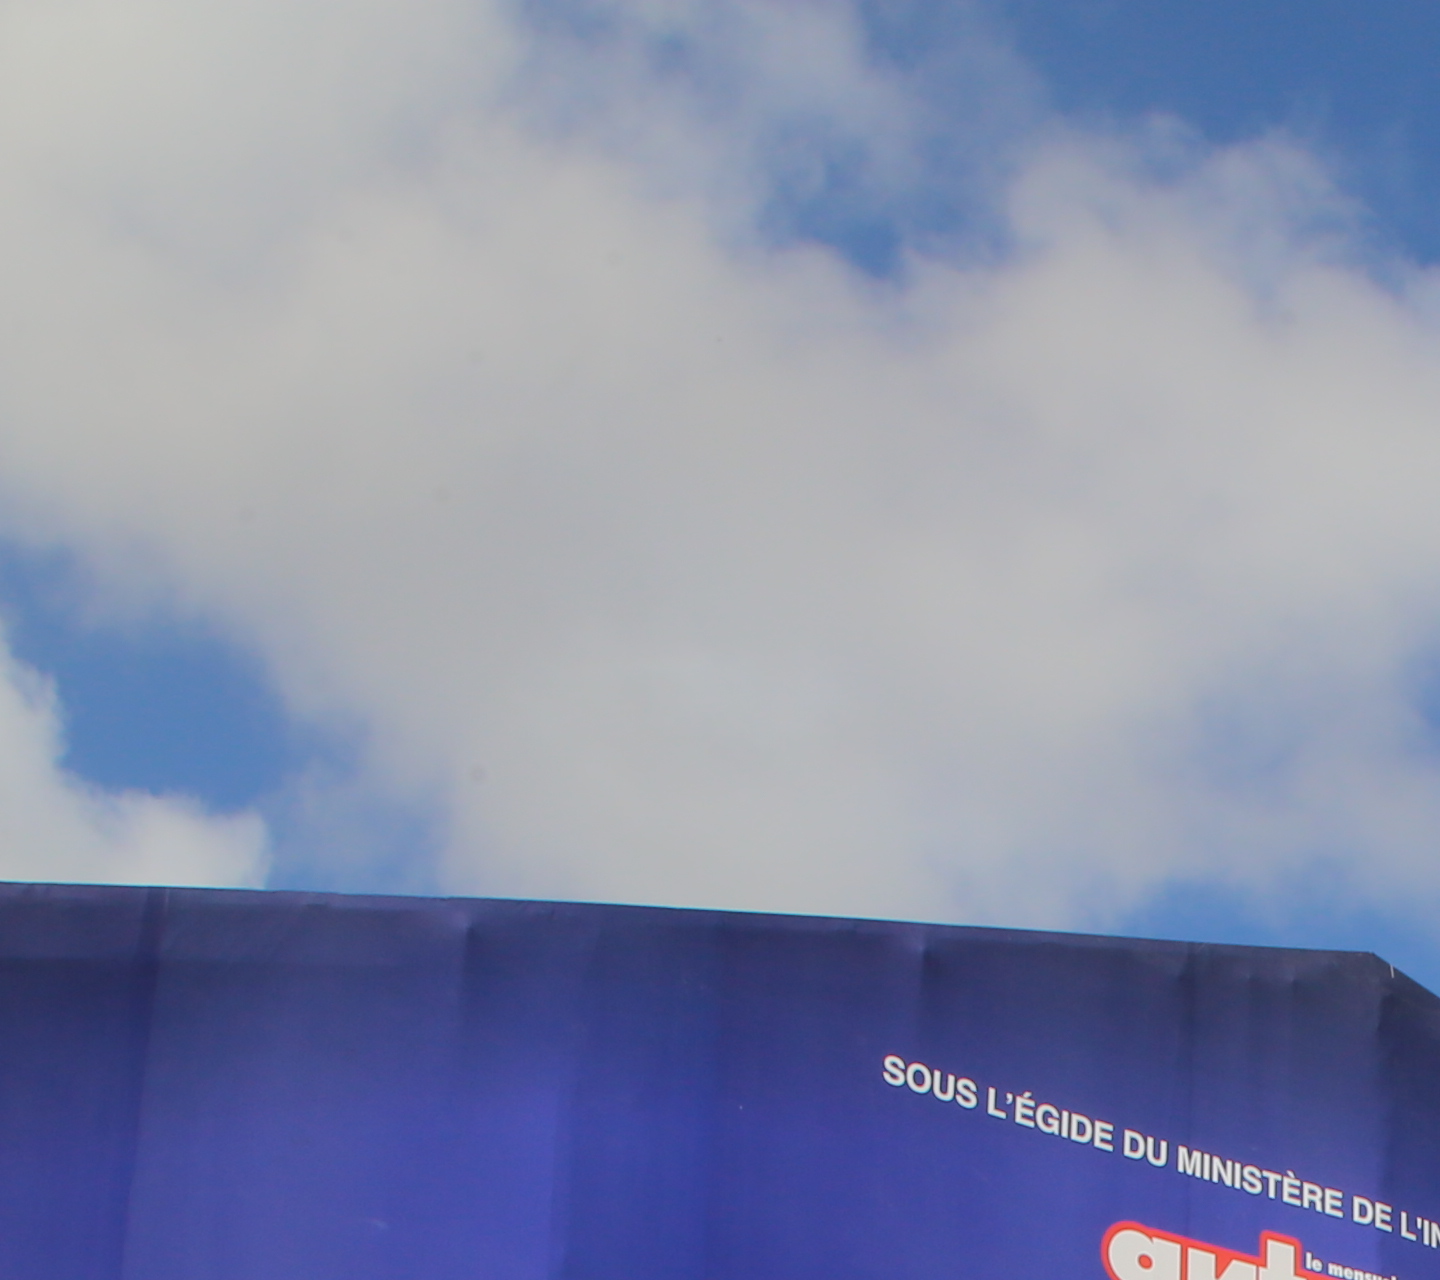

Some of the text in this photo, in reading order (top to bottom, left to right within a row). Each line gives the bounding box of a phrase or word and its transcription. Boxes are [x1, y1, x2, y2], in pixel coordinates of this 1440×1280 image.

[882, 1054, 978, 1109] SOUS
[987, 1087, 1114, 1152] L'ÉGIDE
[1123, 1129, 1168, 1167] DU
[1177, 1144, 1345, 1218] MINISTÈRE
[1352, 1195, 1392, 1233] DE
[1305, 1252, 1323, 1273] le
